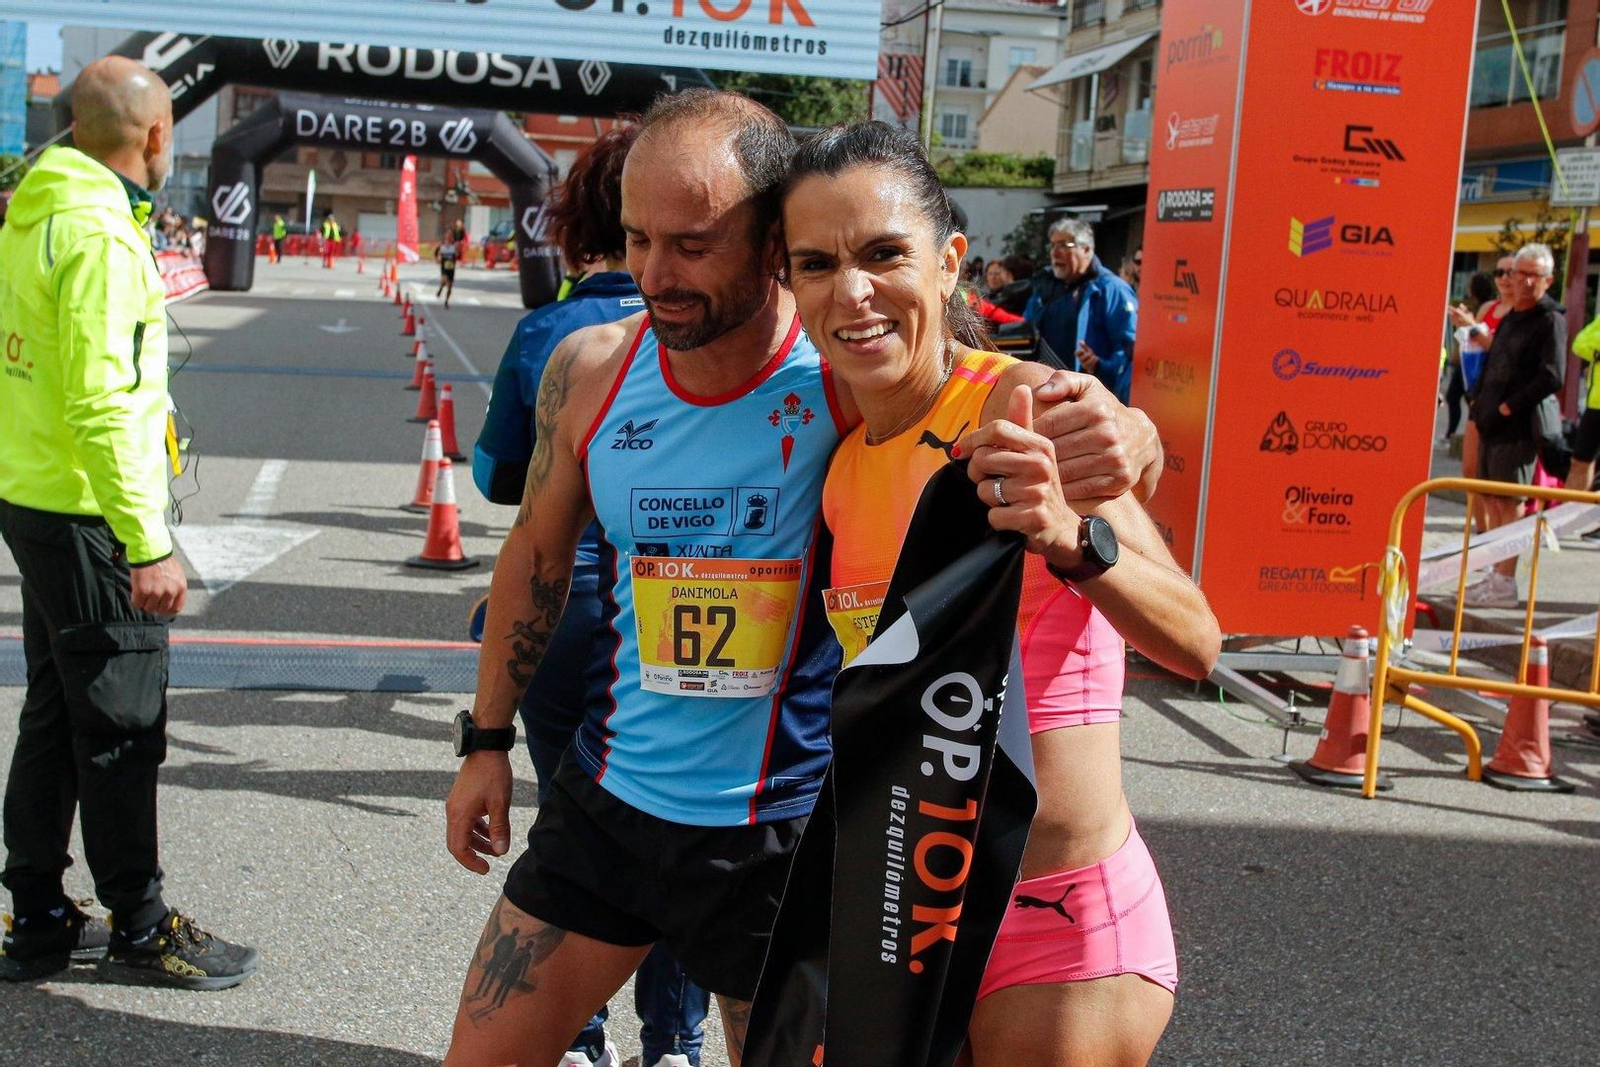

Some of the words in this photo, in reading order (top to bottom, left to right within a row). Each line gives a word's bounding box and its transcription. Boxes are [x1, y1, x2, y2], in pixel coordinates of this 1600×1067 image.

[664, 26, 828, 55] dezquilómetros
[317, 42, 562, 91] RODOSA
[1314, 48, 1403, 82] FROIZ
[1166, 190, 1201, 208] RODOSA
[1340, 224, 1394, 246] GIA
[1274, 287, 1398, 313] QUADRALIA
[1297, 311, 1349, 322] ecommerce
[1356, 313, 1374, 323] web
[1301, 361, 1389, 380] Sumipor
[1305, 421, 1347, 433] GRUPO
[1303, 433, 1387, 452] DONOSO
[638, 497, 725, 512] CONCELLO
[1285, 486, 1354, 506] Oliveira
[648, 516, 670, 530] DE
[674, 514, 715, 528] VIGO
[1308, 507, 1351, 526] Faro.
[1259, 567, 1326, 582] REGATTA
[671, 586, 739, 600] DANIMOLA
[1258, 582, 1293, 592] GREAT
[673, 604, 737, 668] 62
[879, 784, 911, 965] dezquilómetros
